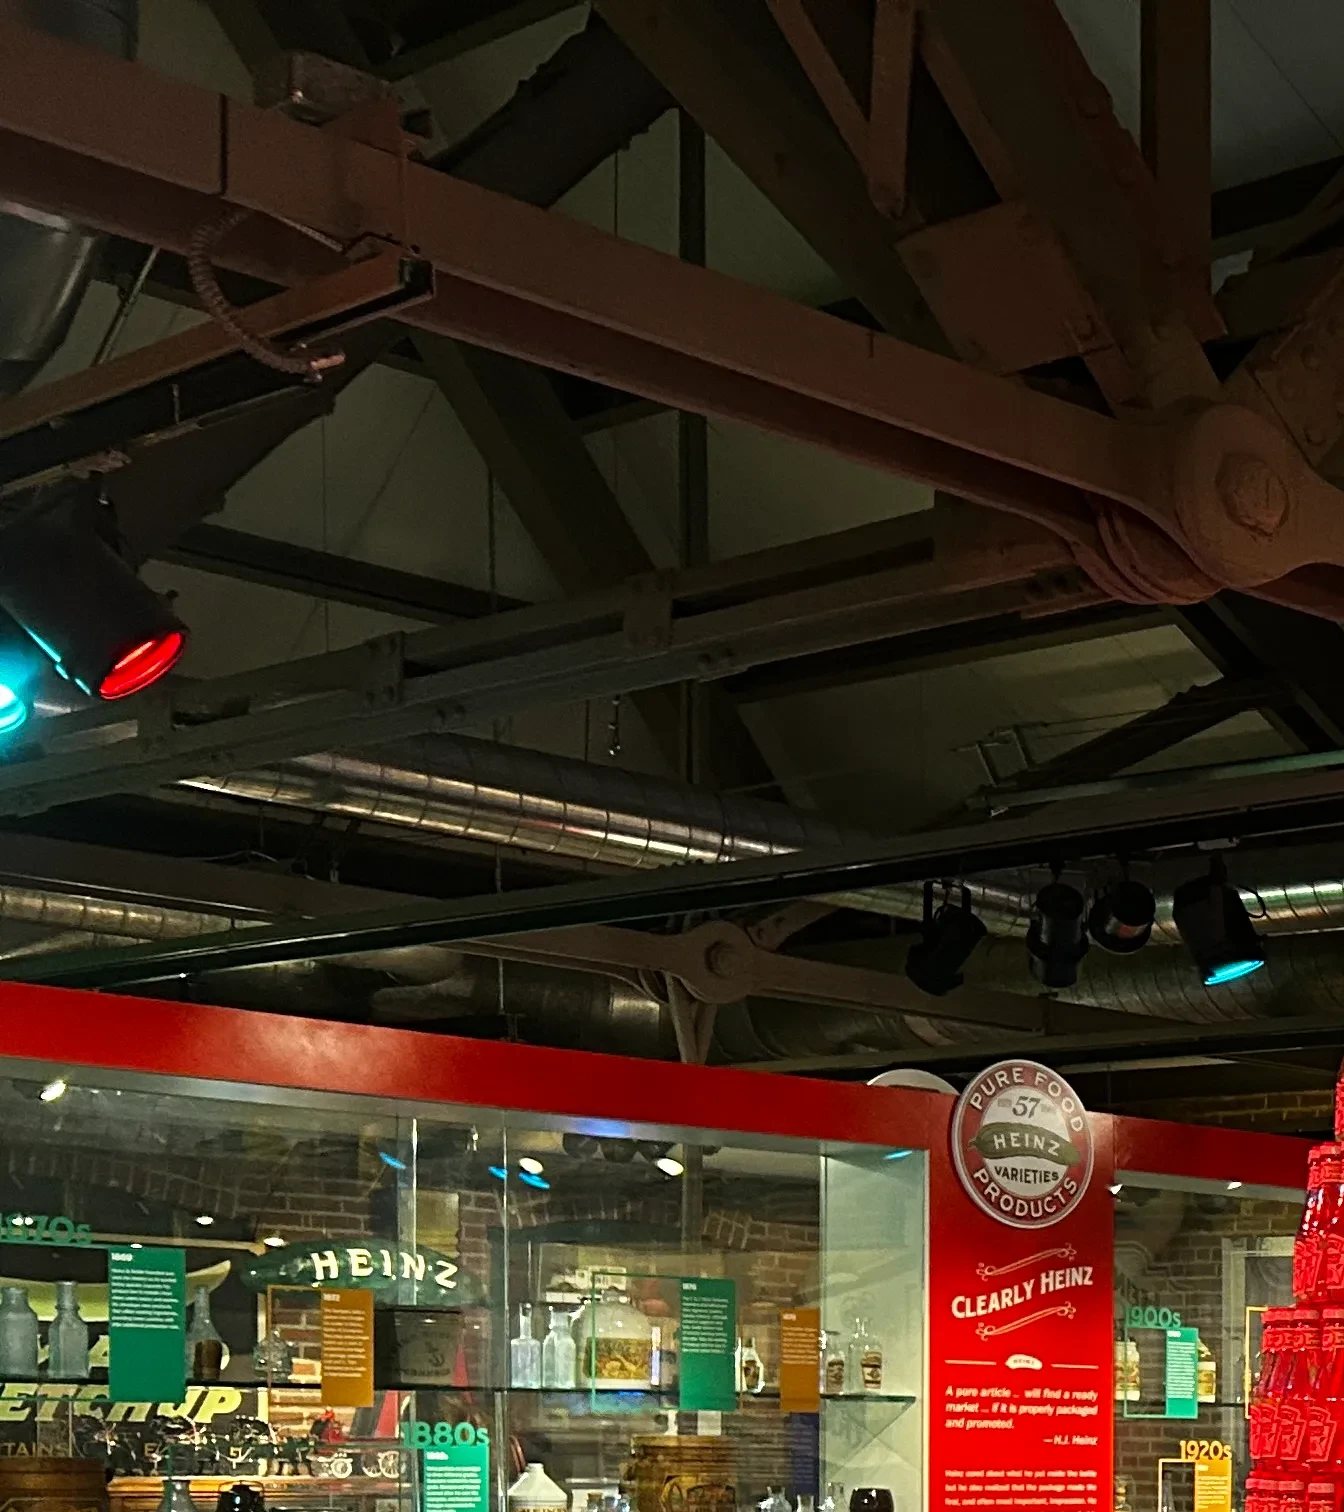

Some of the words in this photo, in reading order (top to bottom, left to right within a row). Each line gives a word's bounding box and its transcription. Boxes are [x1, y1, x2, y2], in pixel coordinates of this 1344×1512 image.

[970, 1067, 1025, 1110] PURE
[1034, 1072, 1084, 1132] FOOD
[1012, 1096, 1041, 1119] 57
[993, 1132, 1061, 1156] HEINZ
[994, 1165, 1060, 1184] VARIETIES
[973, 1168, 1077, 1218] PRODUCTS
[310, 1248, 458, 1289] HEINZ
[951, 1278, 1036, 1319] CLEARLY
[1039, 1266, 1094, 1294] HEINZ
[1125, 1305, 1181, 1327] 1900s
[0, 1383, 242, 1423] ETCHUP
[945, 1385, 953, 1397] A
[401, 1421, 490, 1447] 1880s
[945, 1418, 965, 1429] and
[1179, 1440, 1233, 1461] 1920s
